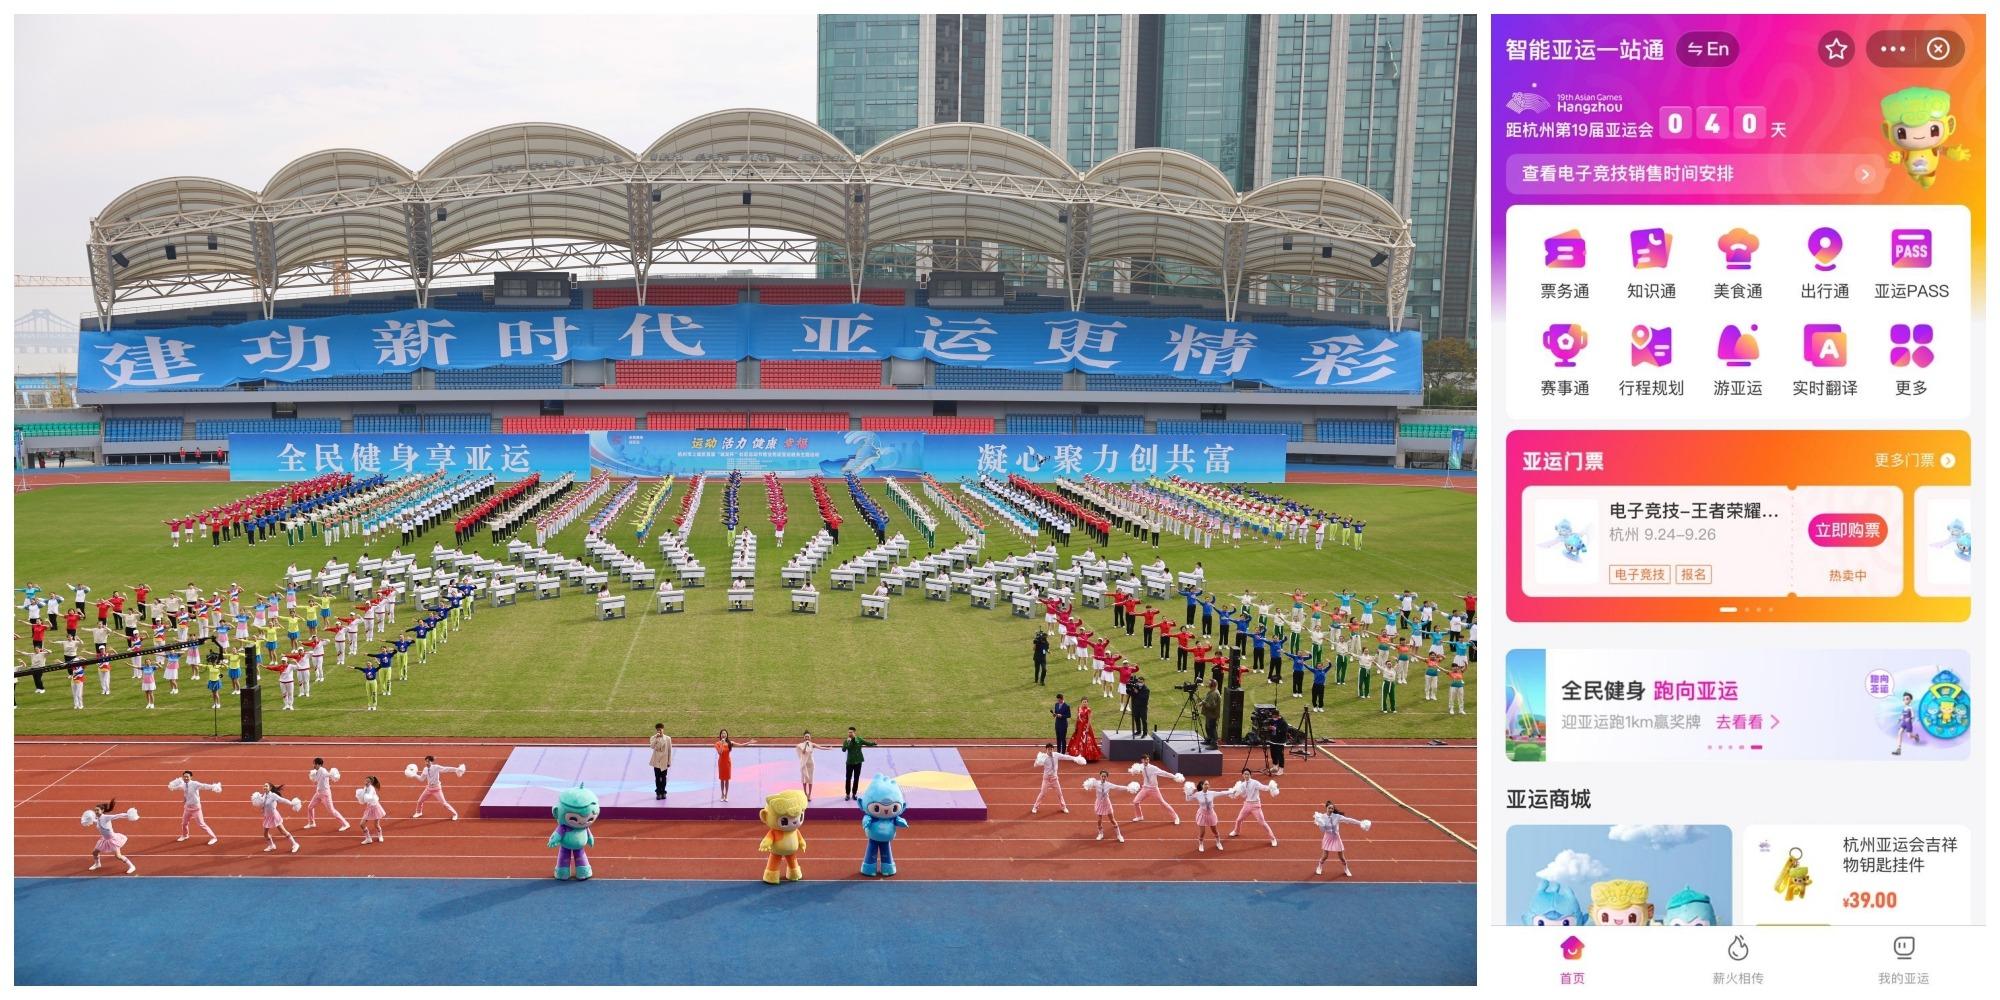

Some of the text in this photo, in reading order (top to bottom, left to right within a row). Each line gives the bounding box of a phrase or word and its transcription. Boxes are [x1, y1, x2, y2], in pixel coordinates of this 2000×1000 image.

[1506, 39, 1664, 60] 智能亚运一站通
[1708, 42, 1729, 56] En
[1556, 92, 1623, 102] 19th Asian Games
[1558, 100, 1622, 114] Hangzhou
[1506, 113, 1786, 138] 距杭州第19届亚运会 0 4 0 天
[1522, 165, 1733, 182] 查看电子竞技销售时间安排
[1896, 244, 1928, 259] PASS
[1541, 283, 1589, 299] 票务通
[1628, 283, 1676, 298] 知识通
[1714, 283, 1762, 298] 美食通
[1802, 283, 1849, 299] 出行通
[1875, 284, 1949, 298] 亚运PASS
[94, 312, 1400, 391] 建功新时代 亚运更精彩
[1541, 380, 1589, 396] 赛事通
[1619, 380, 1683, 396] 行程规划
[1714, 380, 1762, 395] 游亚运
[1793, 380, 1857, 396] 实时翻译
[1896, 380, 1927, 396] 更多
[691, 437, 718, 449] 运动
[721, 437, 748, 450] 活力
[752, 437, 778, 450] 健康
[276, 441, 532, 474] 全民健身享亚运
[977, 442, 1236, 475] 凝心聚力创共富
[1523, 452, 1603, 471] 亚运门票
[1876, 453, 1934, 467] 更多门票
[1609, 527, 1638, 542] 杭州
[1815, 521, 1881, 538] 立即购票
[1616, 568, 1664, 580] 电子竞技
[1682, 568, 1705, 580] 报名
[1829, 569, 1866, 582] 热卖中
[1562, 680, 1738, 701] 全民健身 跑向亚运
[1562, 714, 1763, 729] 迎亚运跑1km赢奖牌 去看看
[1507, 789, 1591, 809] 亚运商城
[1843, 837, 1957, 852] 杭州亚运会吉祥
[1843, 857, 1925, 872] 物钥匙挂件
[1843, 892, 1897, 908] ¥39.00
[1560, 972, 1584, 984] 首页
[1713, 972, 1764, 984] 薪火相传
[1879, 972, 1929, 984] 我的亚运
